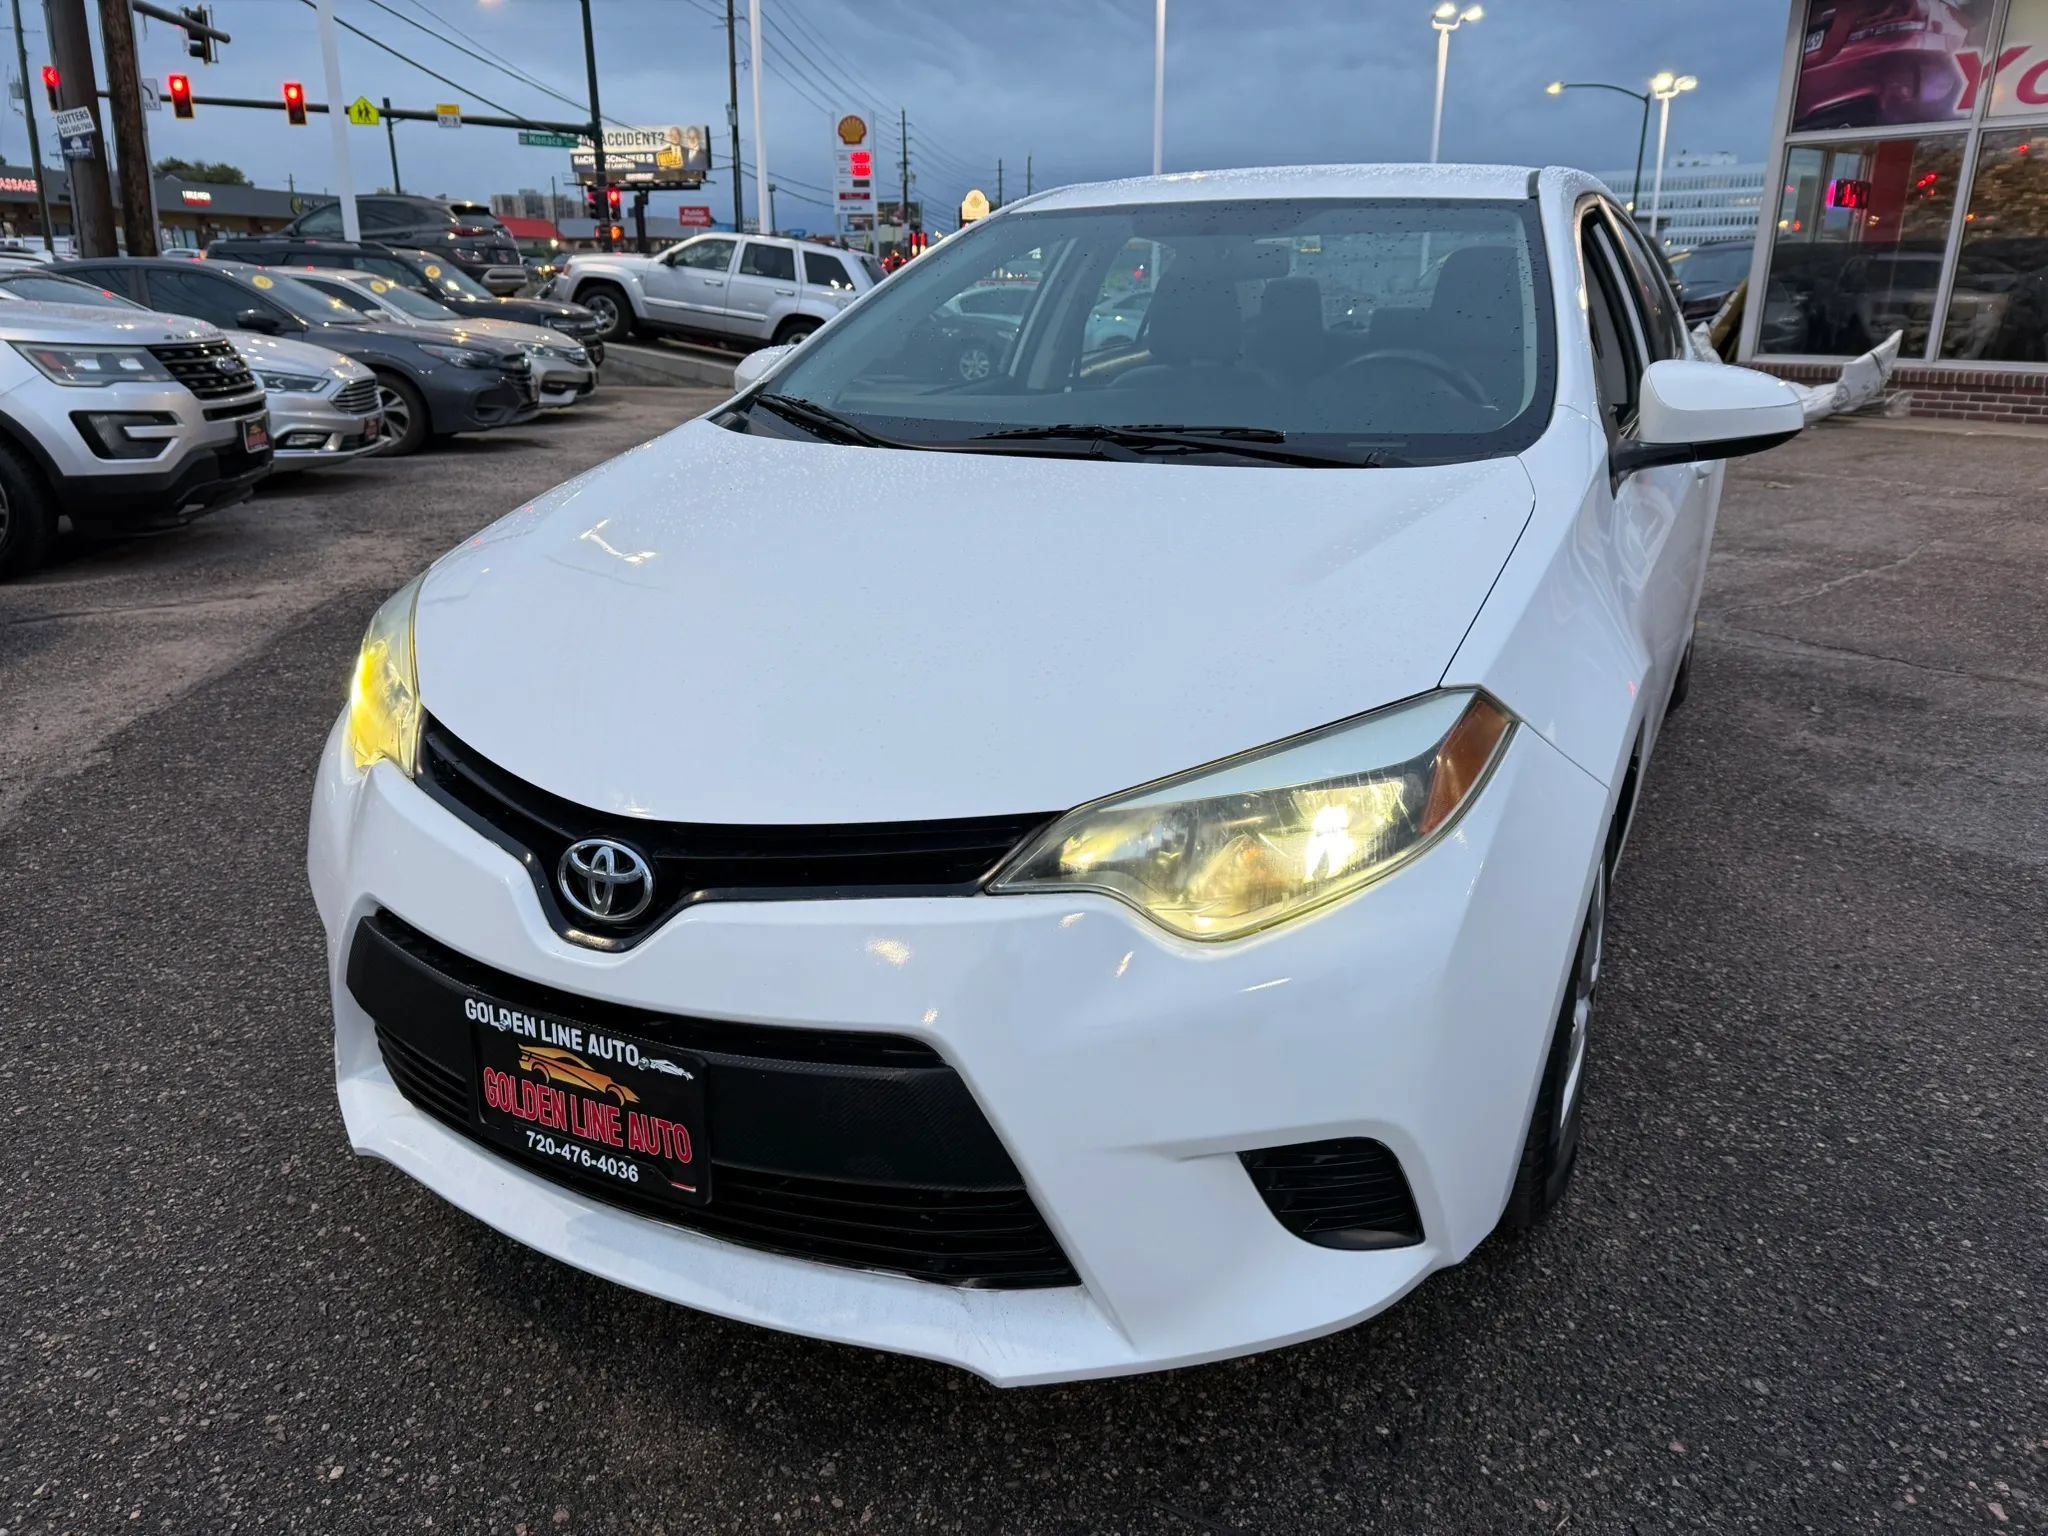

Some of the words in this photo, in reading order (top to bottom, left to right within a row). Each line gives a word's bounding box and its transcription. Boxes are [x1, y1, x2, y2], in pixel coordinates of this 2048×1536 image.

[57, 110, 90, 125] GUTTERS
[528, 135, 563, 146] Monaco
[574, 155, 596, 164] BACH
[464, 998, 537, 1038] GOLDEN
[540, 1020, 583, 1052] LINE
[588, 1033, 639, 1067] AUTO
[483, 1066, 568, 1132] GOLDEN
[570, 1095, 624, 1148] LINE
[628, 1111, 693, 1164] AUTO
[525, 1130, 640, 1183] 720-476-4036
